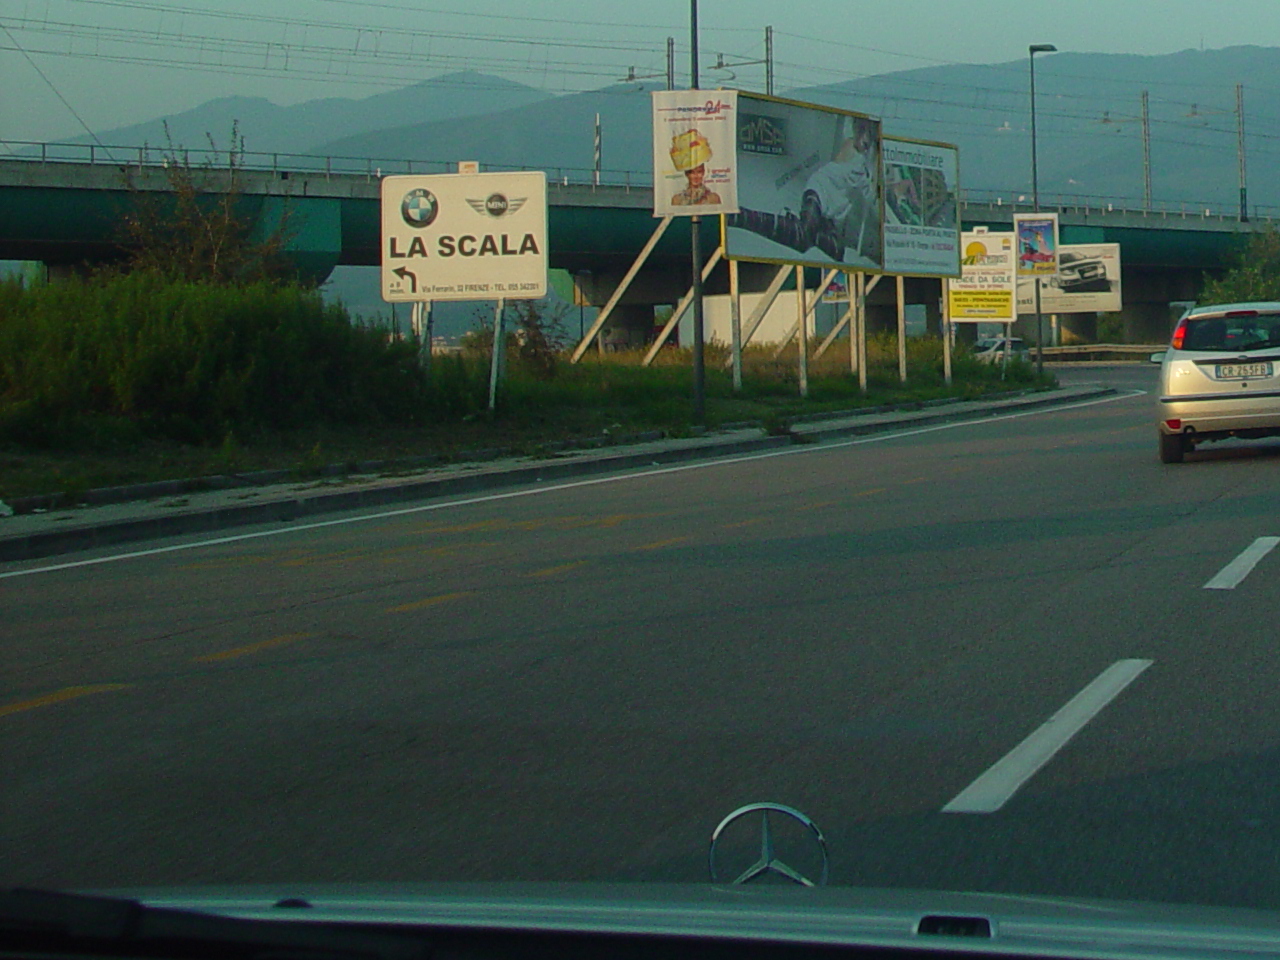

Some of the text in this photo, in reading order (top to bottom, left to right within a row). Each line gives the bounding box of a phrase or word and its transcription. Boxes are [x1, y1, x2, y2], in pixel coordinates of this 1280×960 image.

[487, 201, 507, 209] MINI
[389, 233, 540, 258] LA SCALA
